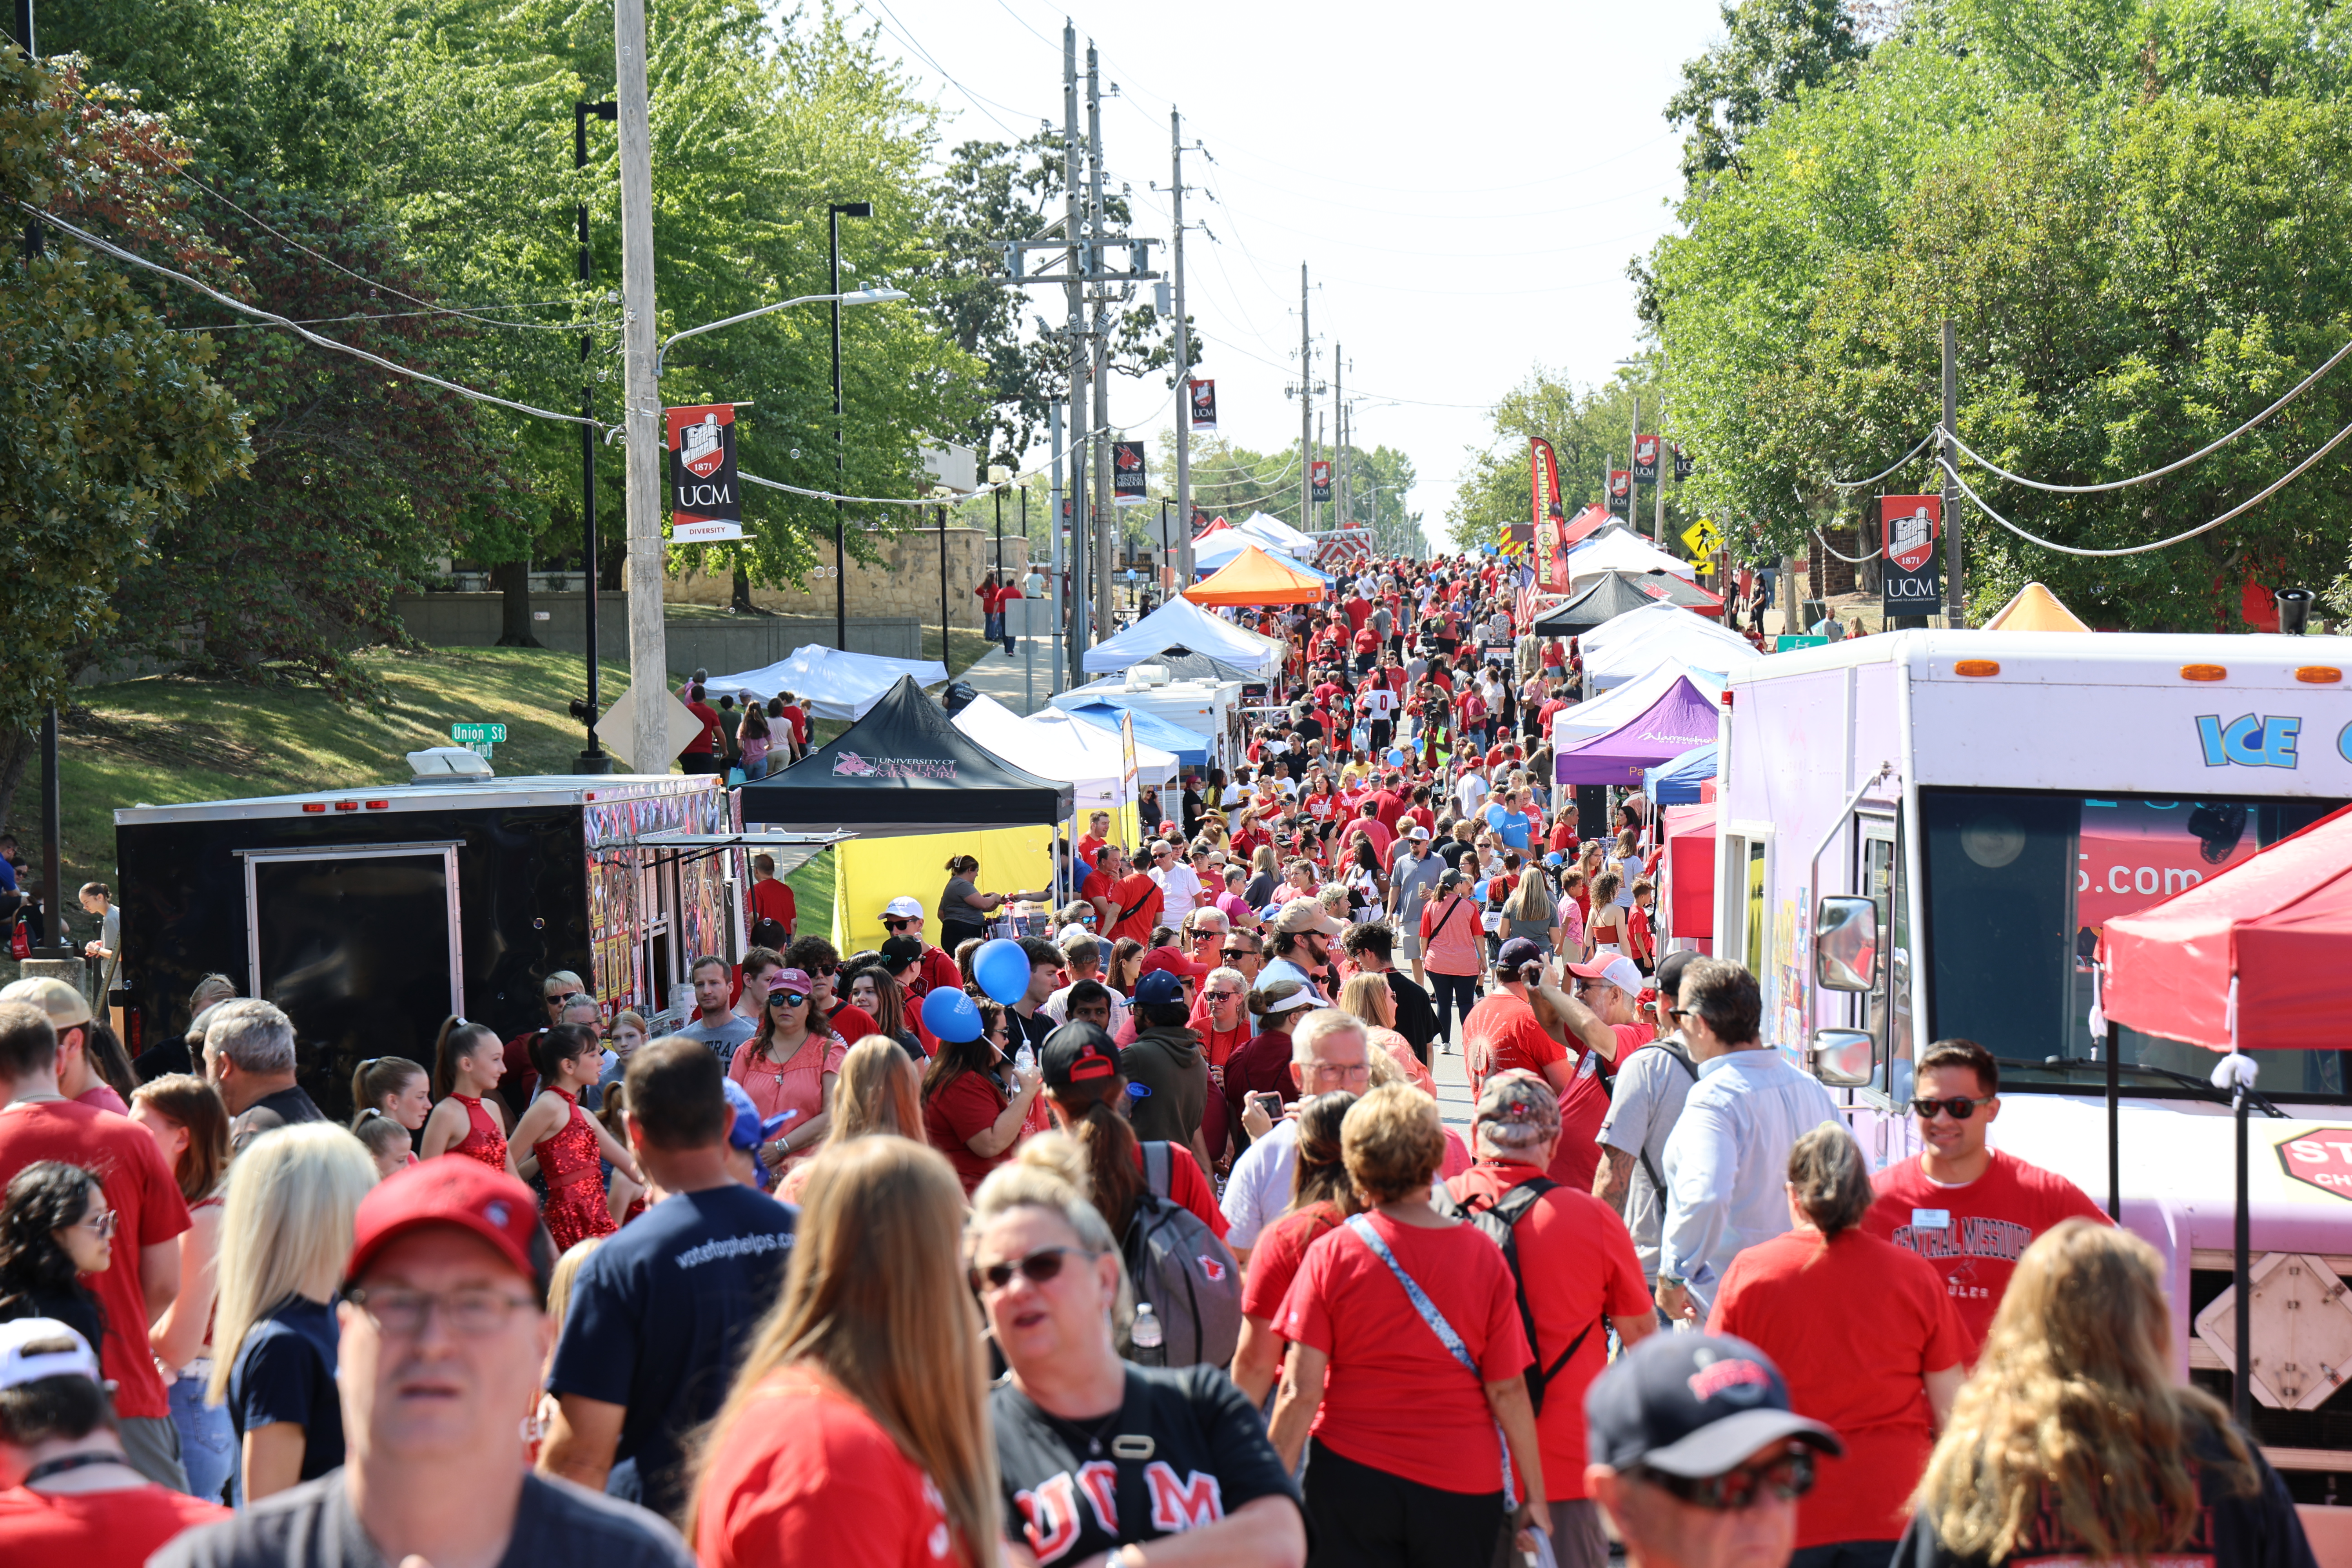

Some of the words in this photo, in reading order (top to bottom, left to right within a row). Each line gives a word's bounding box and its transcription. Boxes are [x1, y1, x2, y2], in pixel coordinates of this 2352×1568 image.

[1194, 408, 1214, 417] UCM
[1635, 467, 1654, 476] UCM
[1534, 445, 1550, 524] CHEESE
[678, 484, 733, 506] UCM
[1537, 532, 1553, 585] CAKE
[1887, 578, 1936, 597] UCM
[454, 726, 484, 739] Union
[492, 726, 503, 739] St
[2194, 712, 2302, 769] ICE
[877, 763, 958, 772] CENTRAL
